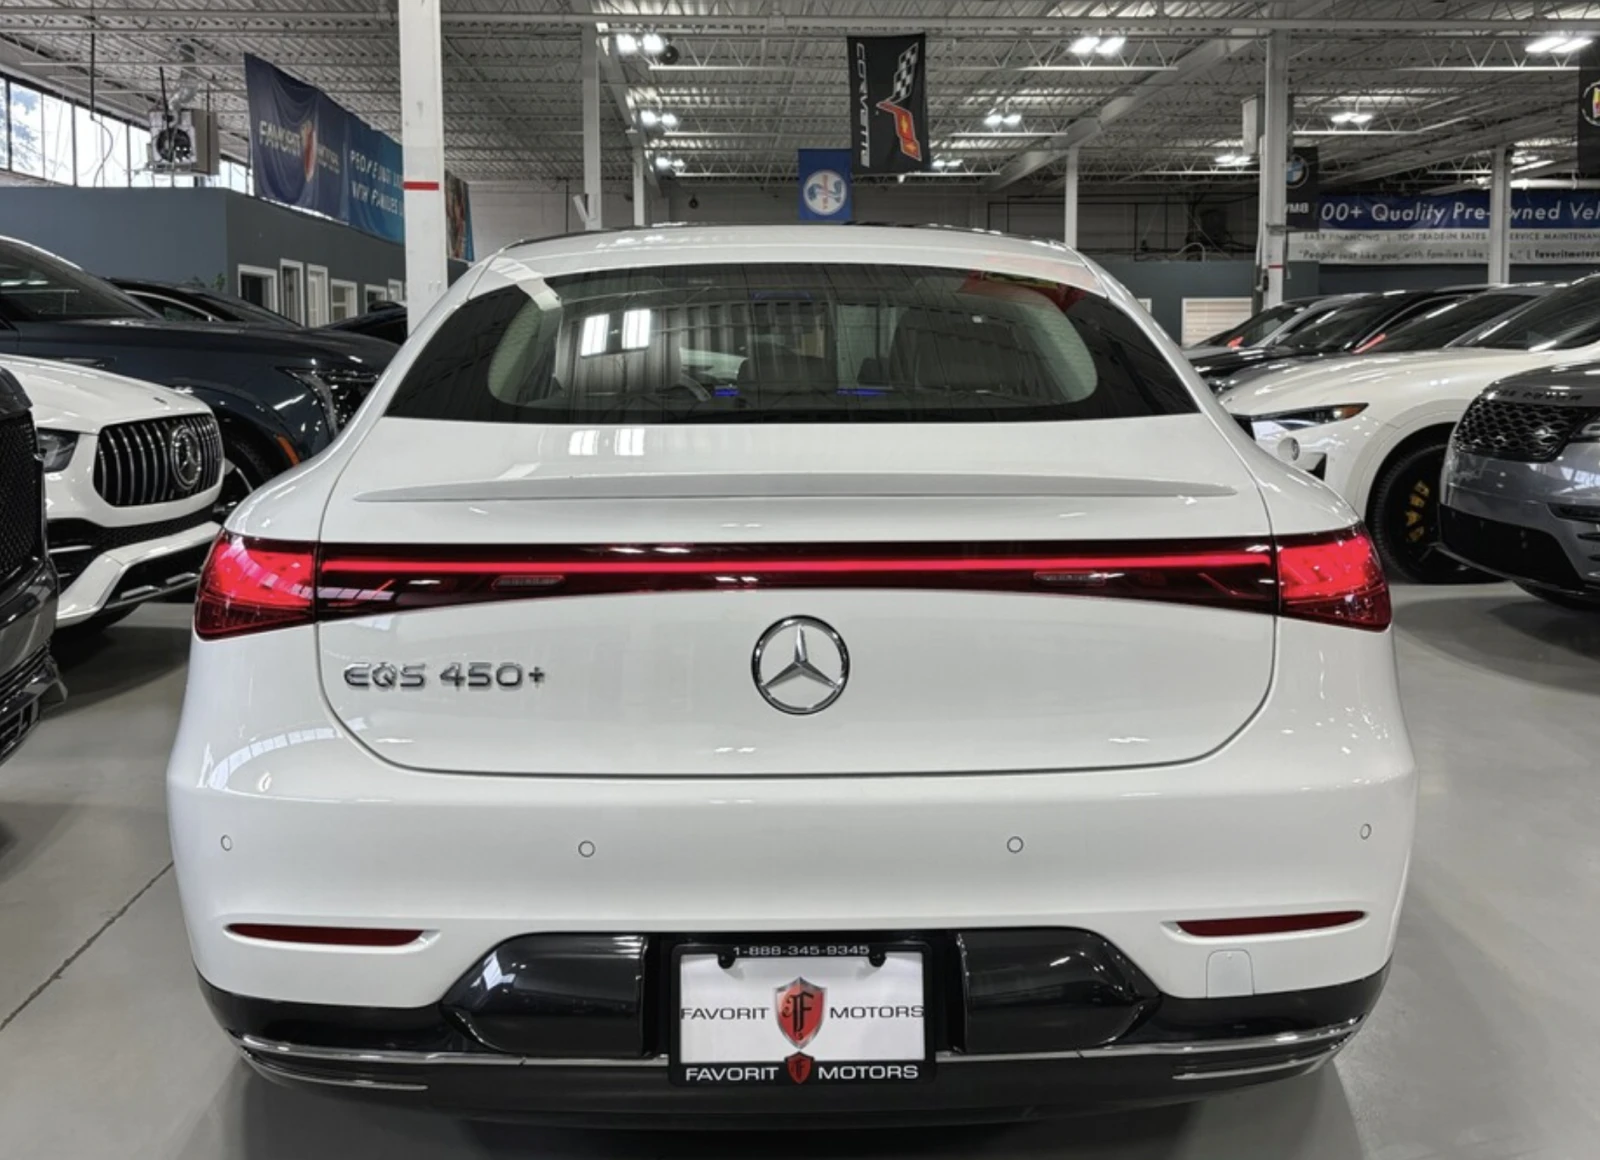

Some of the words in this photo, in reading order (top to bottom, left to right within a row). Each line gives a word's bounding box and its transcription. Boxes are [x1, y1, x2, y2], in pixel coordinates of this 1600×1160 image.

[857, 42, 869, 168] CORVETTE
[1321, 203, 1363, 221] 00+
[1371, 202, 1445, 225] Quality
[1453, 201, 1561, 220] Pre-wned
[1509, 231, 1540, 241] ERVICE
[344, 662, 426, 690] EQS
[439, 662, 545, 690] 450+
[733, 945, 870, 956] 1-888-345-9345
[680, 1007, 770, 1020] FAVORIT
[830, 1005, 925, 1019] MOTORS
[685, 1067, 779, 1081] FAVORIT
[818, 1065, 919, 1080] MOTORS
